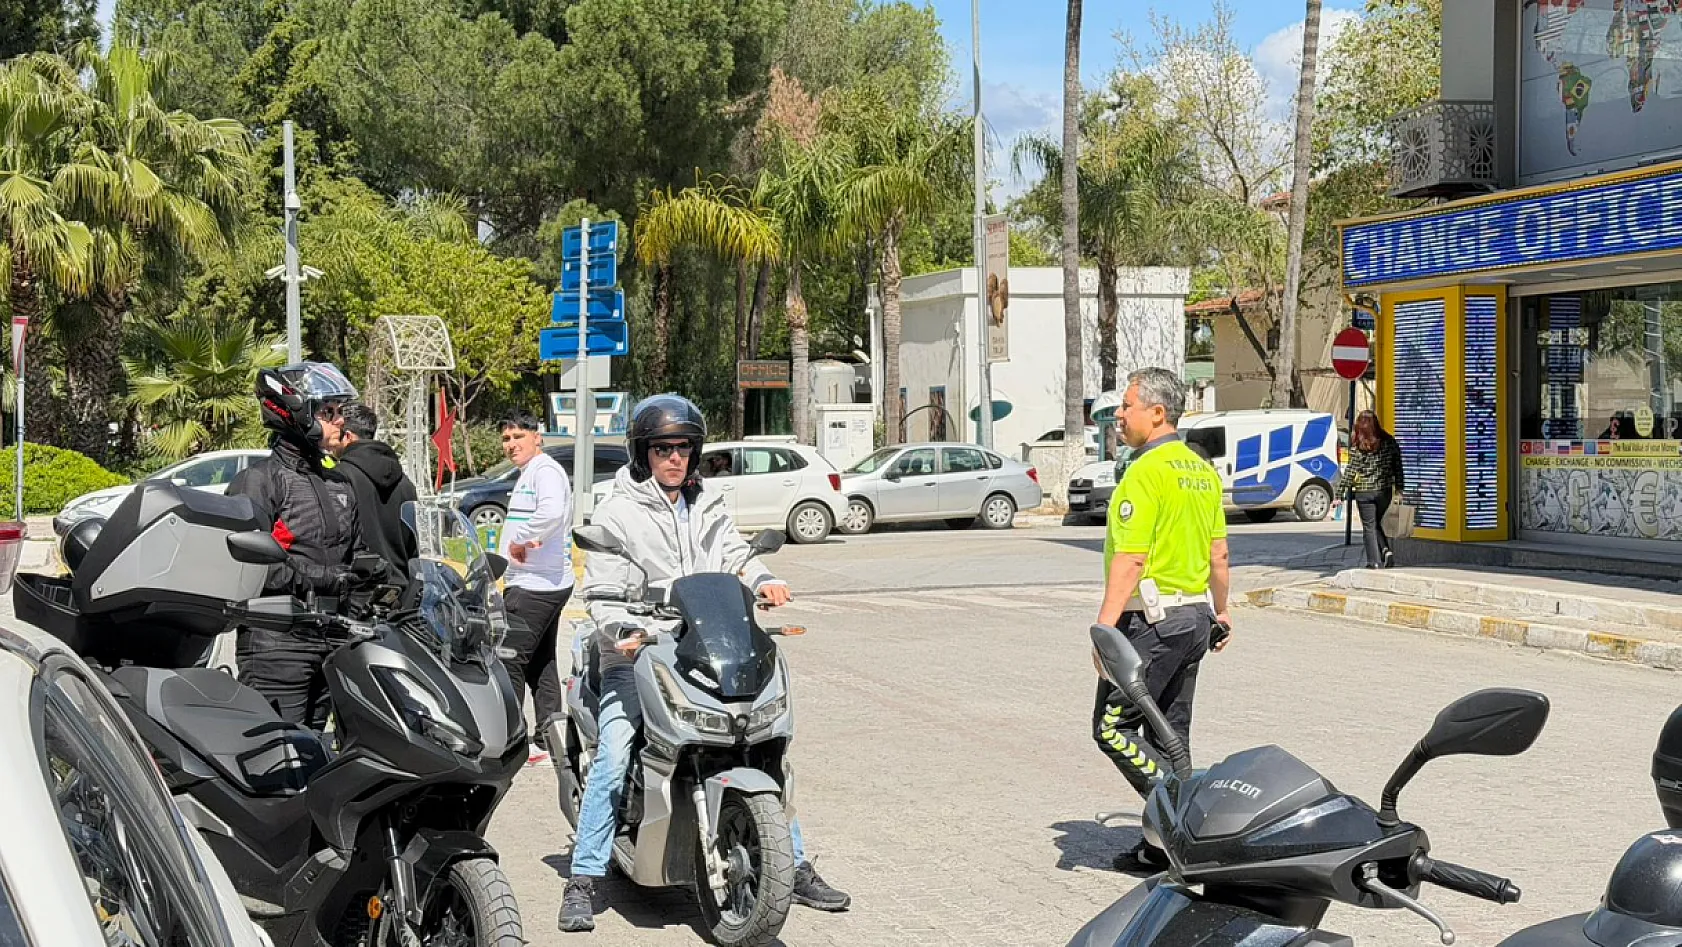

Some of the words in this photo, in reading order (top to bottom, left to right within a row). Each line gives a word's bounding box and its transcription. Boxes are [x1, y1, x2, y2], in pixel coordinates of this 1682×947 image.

[1344, 209, 1501, 280] CHANGE
[1514, 178, 1682, 255] OFFICE
[1525, 457, 1551, 466] CHANGE
[1555, 457, 1589, 467] EXCHANGE
[1594, 458, 1605, 467] NO
[1606, 458, 1652, 468] COMMISSION
